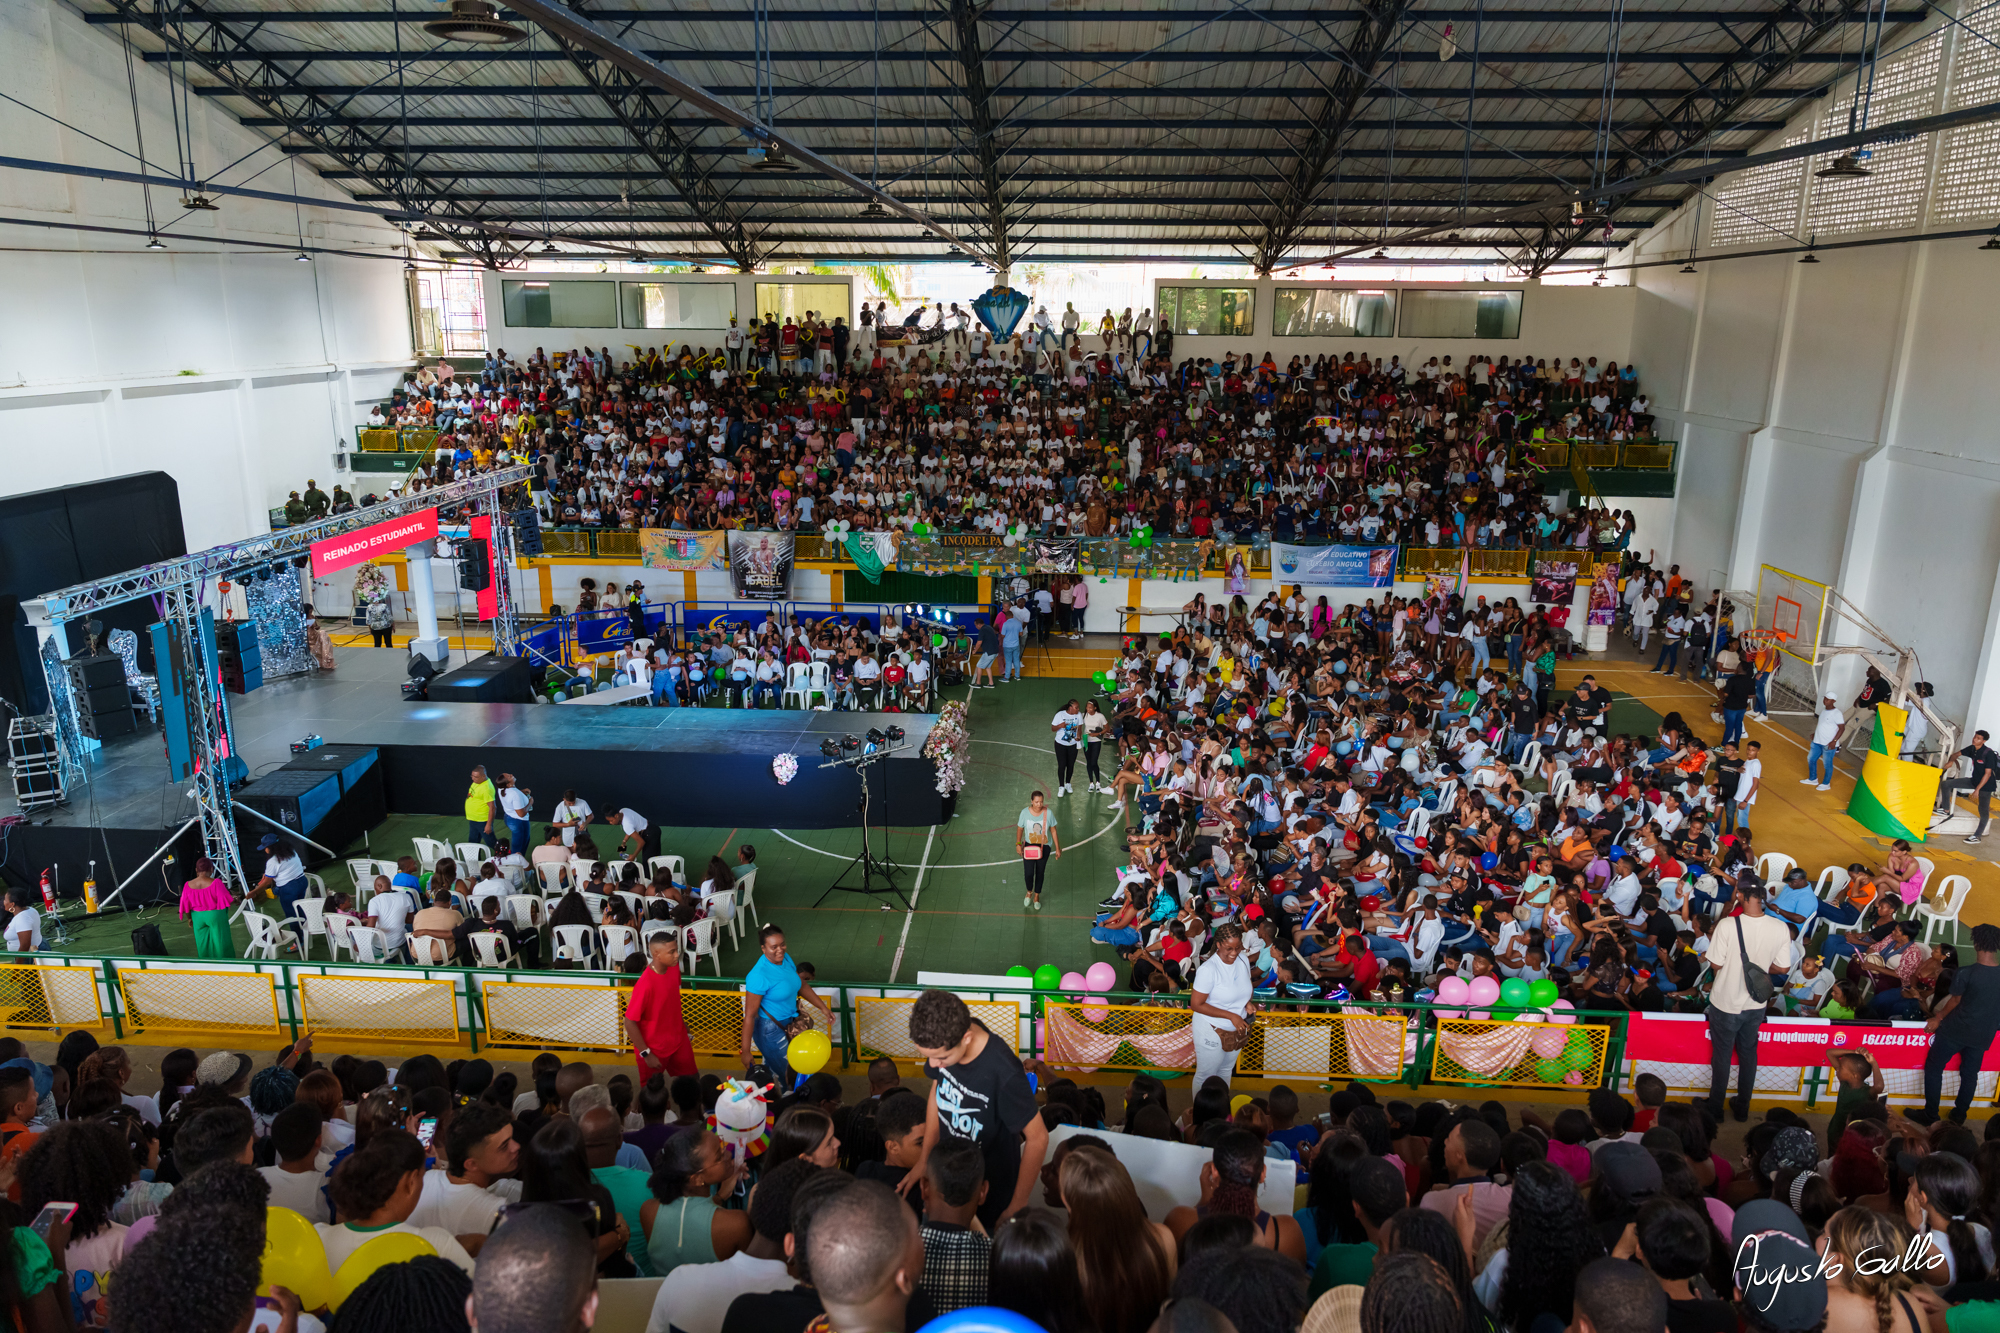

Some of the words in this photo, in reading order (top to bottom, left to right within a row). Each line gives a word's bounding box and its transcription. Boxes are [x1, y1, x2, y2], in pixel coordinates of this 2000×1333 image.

[323, 541, 369, 562] REINADO
[370, 522, 425, 556] ESTUDIANTIL
[745, 575, 783, 586] ISABEL
[1773, 1031, 1829, 1044] Champion
[1862, 1034, 1905, 1046] 8137791
[1905, 1035, 1927, 1047] 321
